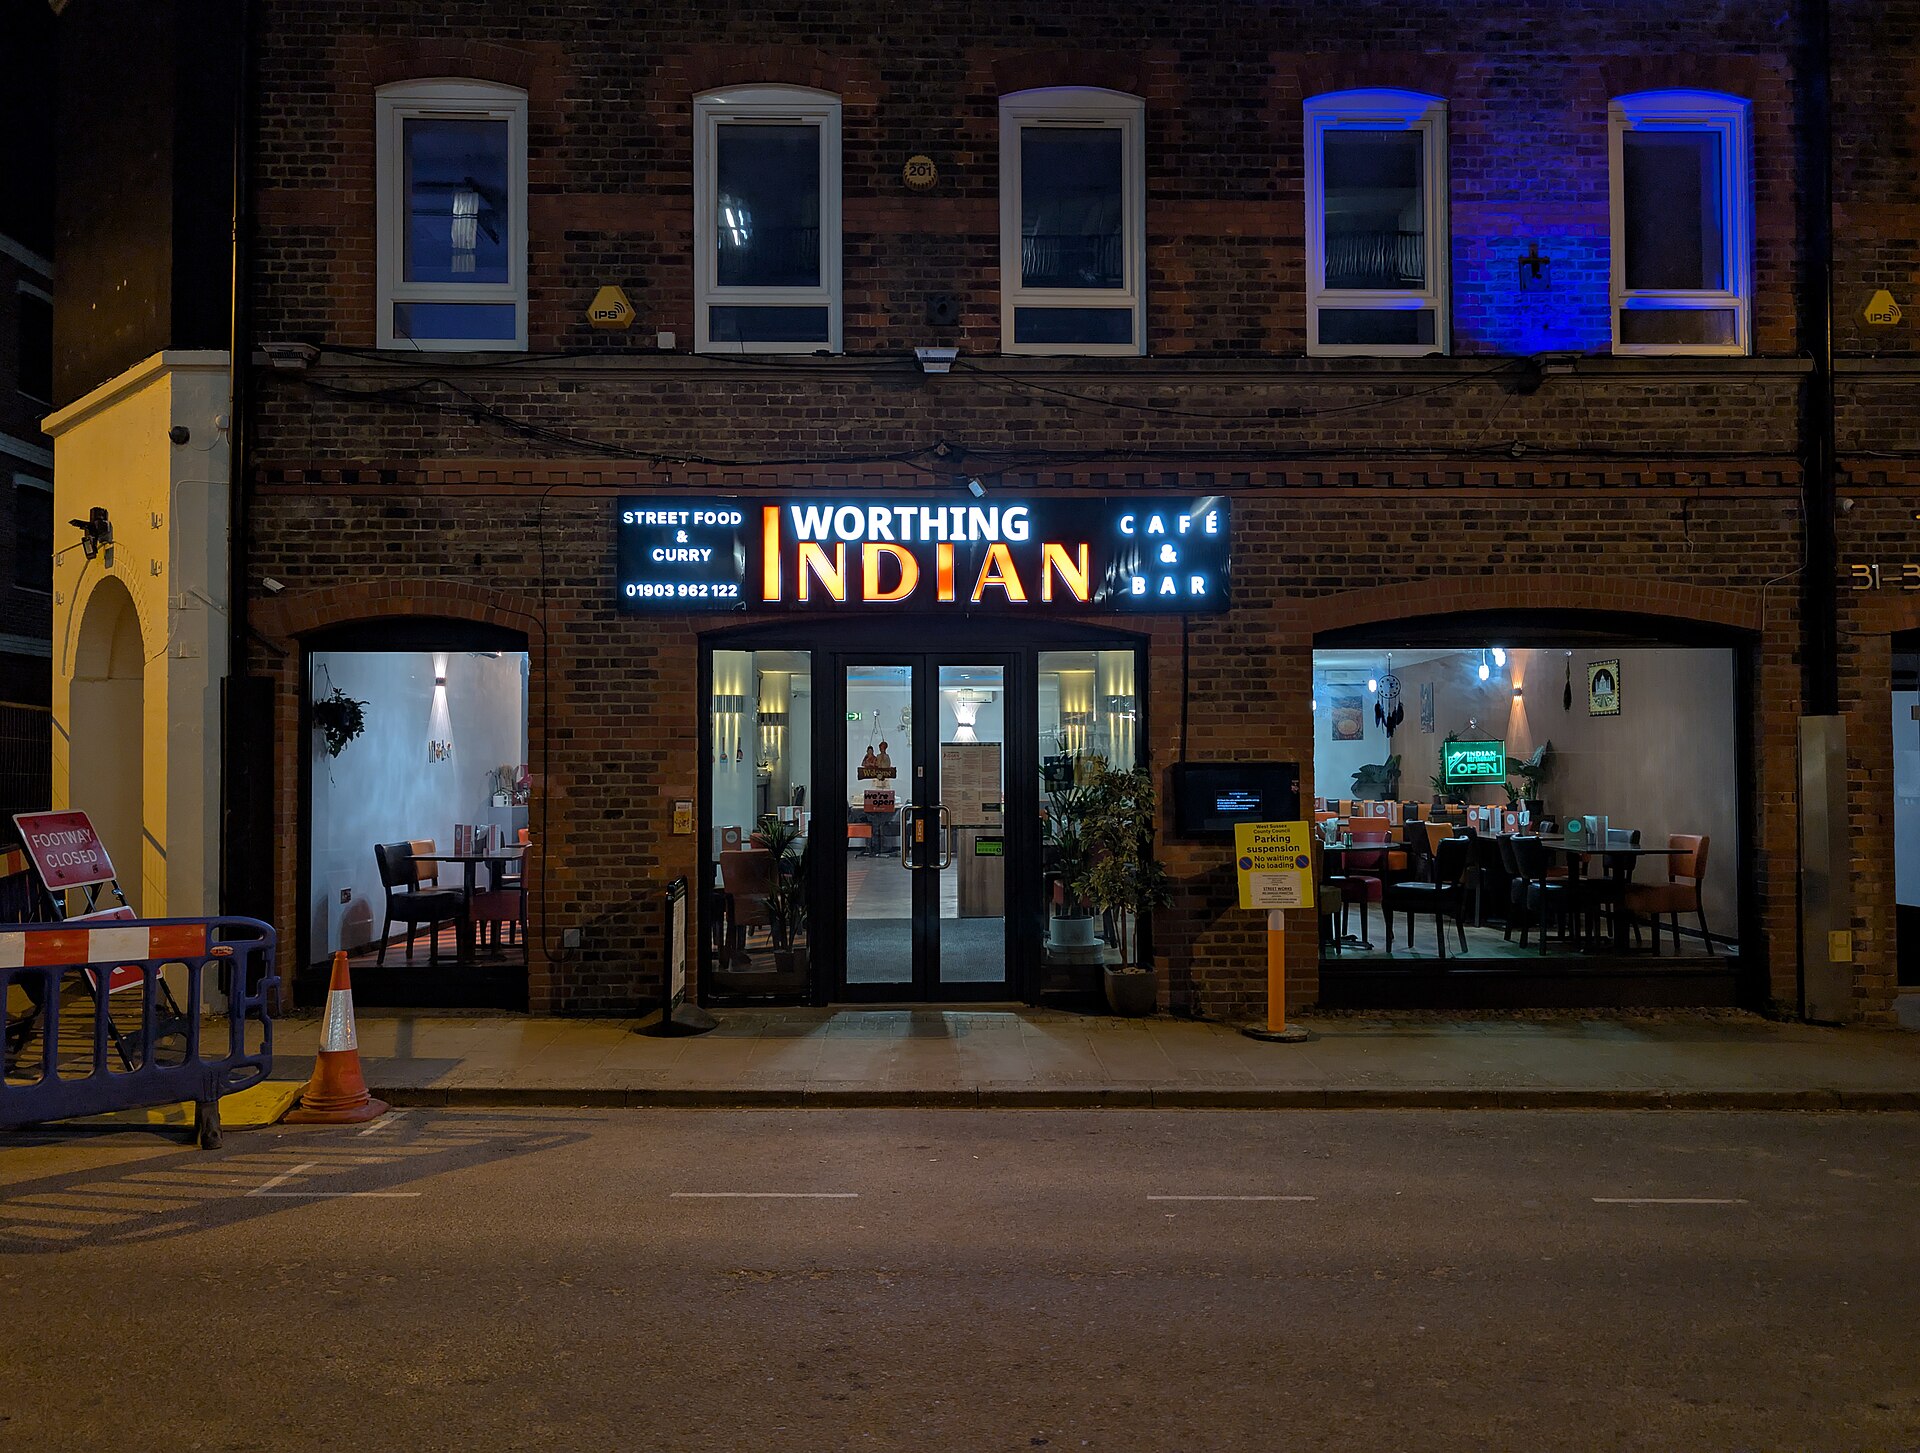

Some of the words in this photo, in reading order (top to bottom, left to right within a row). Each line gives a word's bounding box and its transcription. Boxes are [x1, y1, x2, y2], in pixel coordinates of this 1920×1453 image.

[909, 166, 932, 177] 201
[594, 310, 618, 319] IPS
[1870, 313, 1892, 322] IPS
[623, 511, 689, 525] STREET
[694, 511, 742, 525] FOOD
[791, 505, 1029, 541] WORTHING
[1120, 510, 1218, 534] CAFÉ
[676, 530, 688, 543] &
[652, 548, 711, 562] CURRY
[762, 505, 1090, 602] INDIAN
[1160, 544, 1177, 563] &
[626, 584, 675, 597] 01903
[678, 584, 708, 597] 962
[711, 584, 738, 597] 122
[1131, 576, 1206, 595] BAR
[1457, 763, 1497, 774] OPEN
[872, 799, 895, 807] open
[31, 828, 93, 849] FOOTWAY
[1254, 835, 1291, 844] Parking
[1246, 844, 1300, 853] suspension
[46, 849, 98, 868] CLOSED
[1267, 862, 1294, 870] loading
